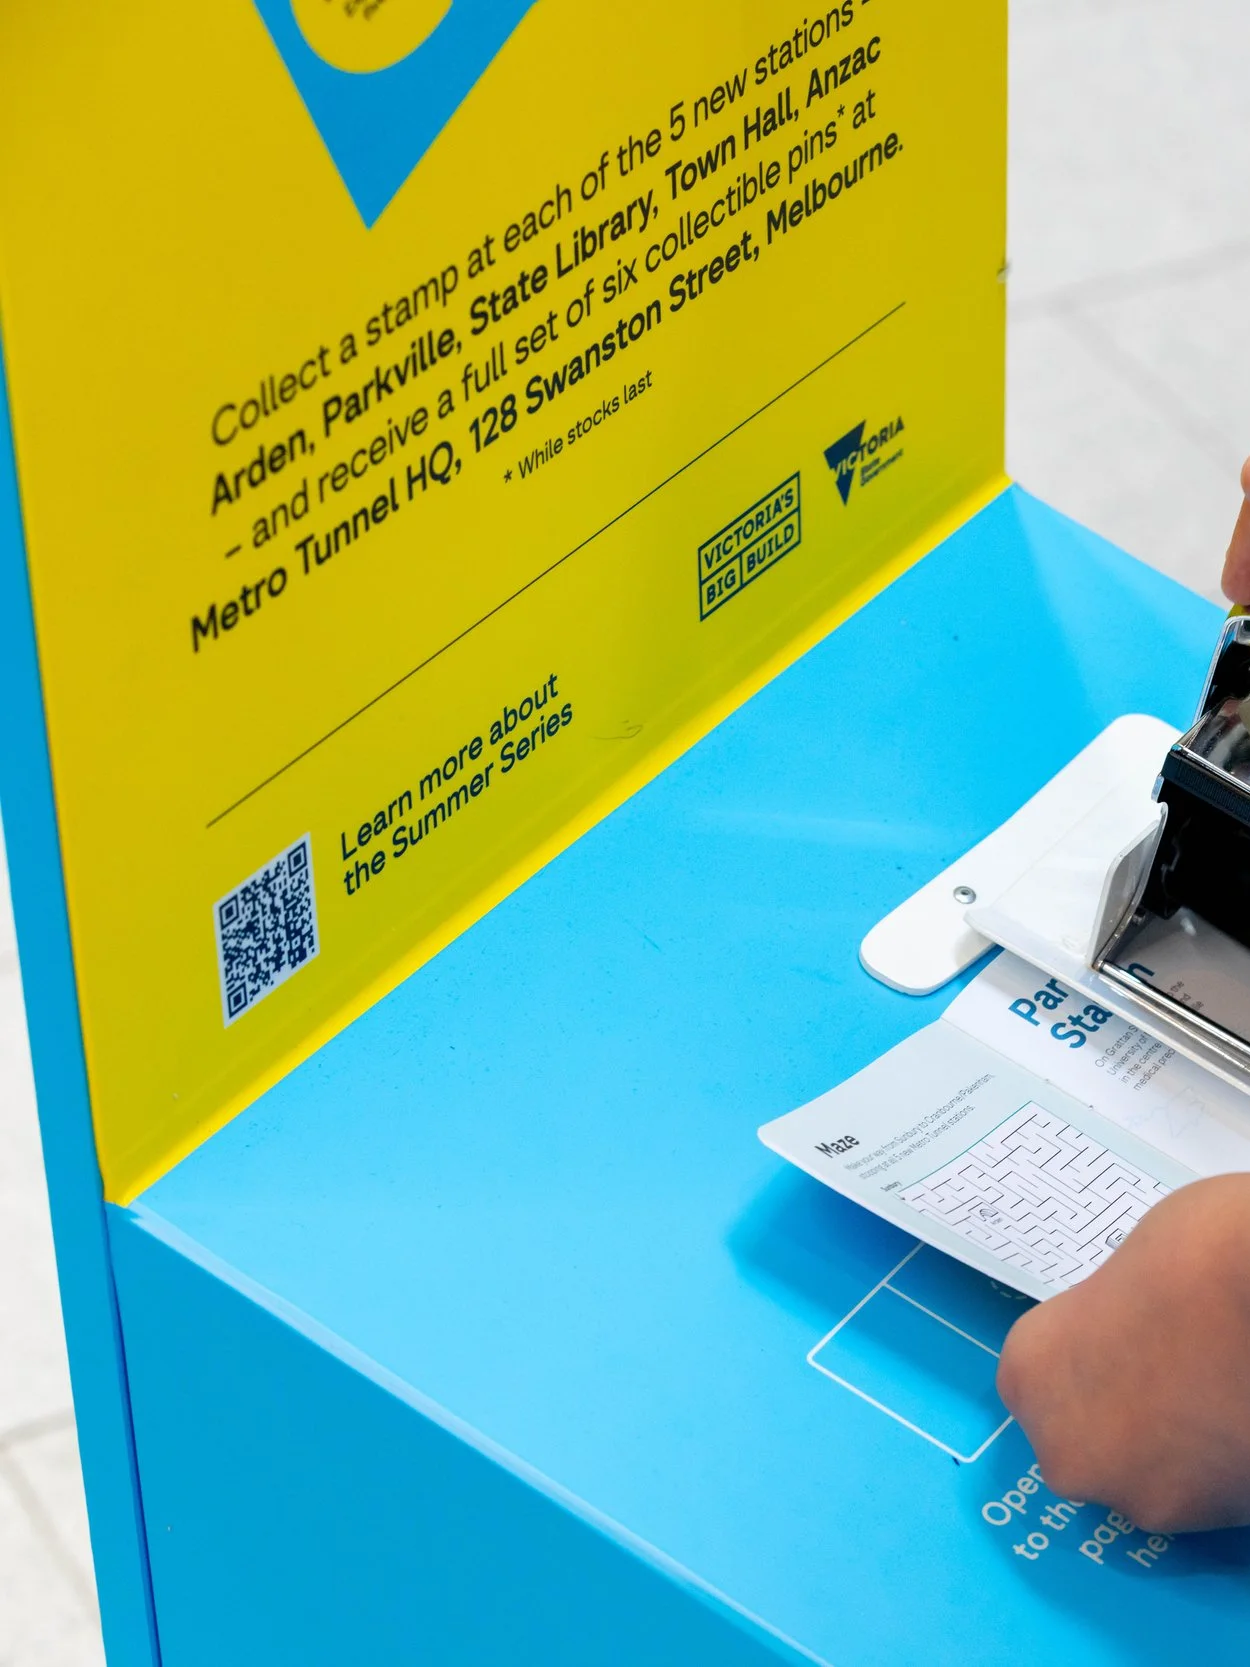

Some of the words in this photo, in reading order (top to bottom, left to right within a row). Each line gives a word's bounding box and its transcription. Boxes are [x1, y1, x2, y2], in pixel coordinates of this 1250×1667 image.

[212, 347, 330, 446] Collect
[340, 333, 358, 365] a
[366, 265, 458, 347] stamp
[467, 235, 496, 279] at
[503, 184, 572, 253] each
[580, 151, 609, 201] of
[616, 128, 662, 177] the
[670, 100, 686, 142] 5
[693, 68, 748, 128] new
[754, 0, 854, 86] stations
[212, 429, 315, 515] Arden,
[323, 328, 462, 438] Parkville,
[469, 264, 549, 336] State
[555, 189, 659, 279] Library,
[664, 134, 736, 201] Town
[743, 86, 799, 151] Hall,
[805, 35, 881, 109] Anzac
[253, 479, 309, 548] and
[318, 407, 429, 503] receive
[437, 389, 455, 420] a
[461, 341, 508, 402] full
[515, 311, 559, 365] set
[566, 277, 595, 328] of
[602, 258, 638, 304] six
[645, 160, 781, 273] collectible
[852, 89, 876, 130] at
[191, 567, 287, 653] Metro
[294, 477, 400, 575] Tunnel
[406, 440, 462, 501] HQ,
[469, 393, 518, 453] 128
[525, 299, 662, 415] Swanston
[669, 230, 760, 313] Street,
[766, 132, 903, 246] Melbourne.
[518, 437, 564, 479] While
[567, 396, 620, 445] stocks
[623, 370, 653, 405] last
[831, 415, 905, 482] VICTORIA
[703, 487, 795, 571] VICTORIA'S
[706, 568, 737, 605] BIG
[746, 522, 795, 574] BUILD
[340, 790, 413, 862] Learn
[419, 735, 484, 801] more
[489, 673, 559, 746] about
[343, 850, 386, 896] the
[391, 761, 495, 859] Summer
[499, 702, 573, 774] Series
[1008, 978, 1069, 1027] Par
[1095, 1055, 1109, 1068] On
[1105, 1031, 1133, 1057] Grattan
[1106, 1041, 1143, 1076] University
[1126, 1062, 1142, 1077] the
[1138, 1041, 1162, 1065] centre
[1133, 1061, 1161, 1091] medical
[814, 1135, 860, 1159] Maze
[1012, 1532, 1049, 1560] to
[1079, 1508, 1136, 1565] pag
